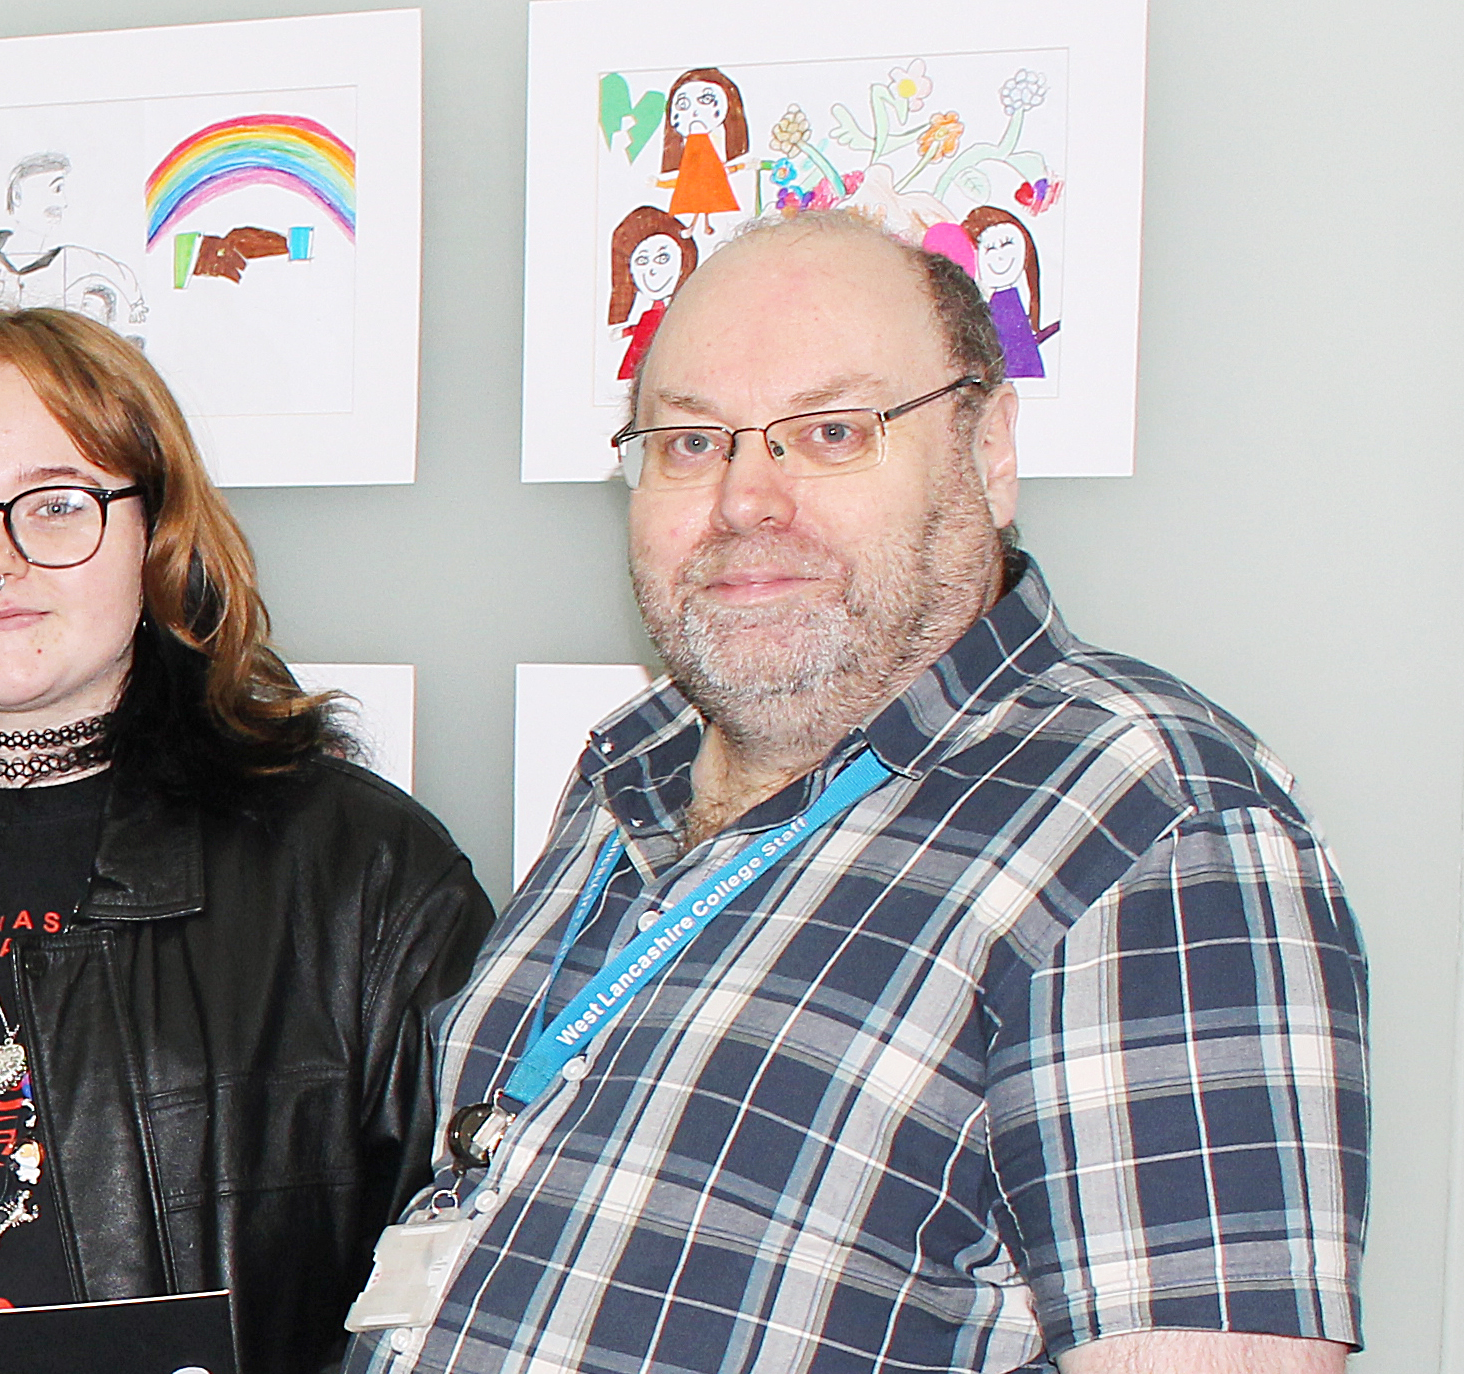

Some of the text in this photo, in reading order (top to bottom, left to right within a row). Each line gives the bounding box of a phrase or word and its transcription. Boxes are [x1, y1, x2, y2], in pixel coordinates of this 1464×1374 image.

[556, 817, 809, 1046] West Lancashire College Staff
